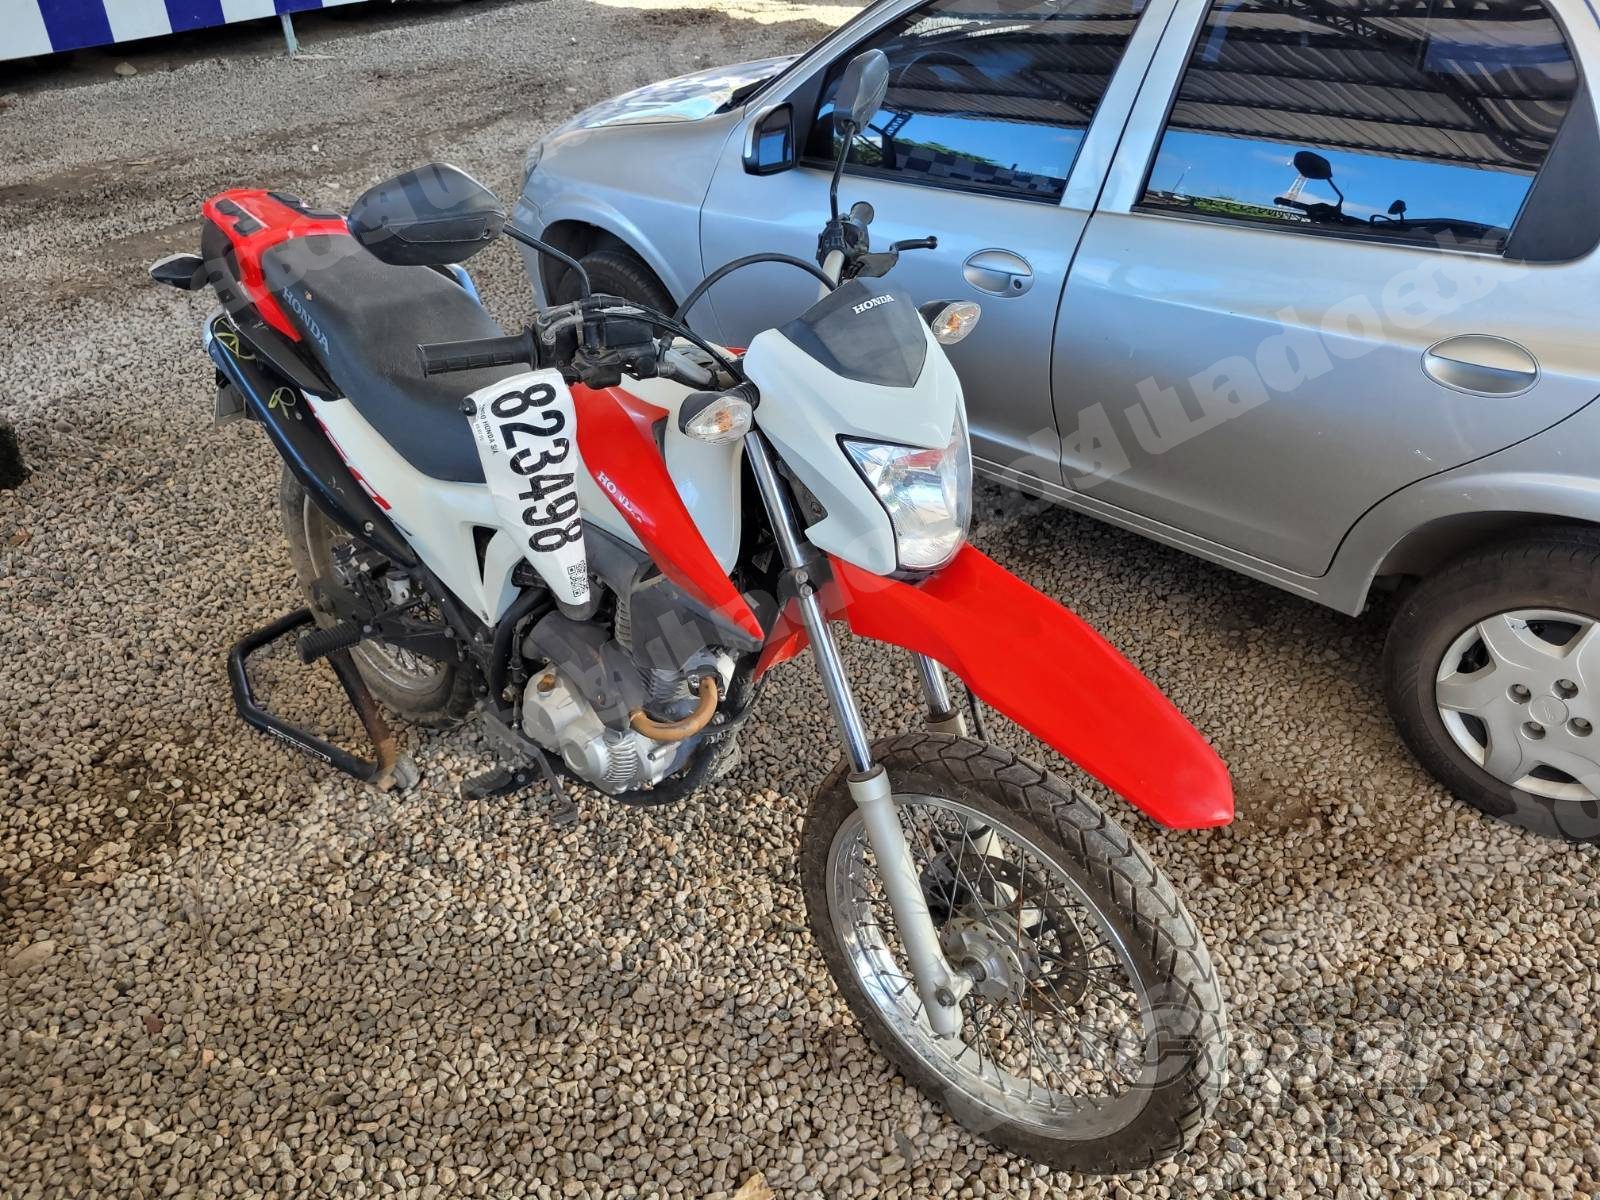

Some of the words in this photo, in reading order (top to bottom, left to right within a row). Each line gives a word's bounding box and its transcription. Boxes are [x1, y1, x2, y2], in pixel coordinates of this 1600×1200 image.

[283, 286, 330, 354] HONDA
[851, 294, 895, 315] HONDA
[482, 420, 496, 443] HONDA
[490, 382, 583, 553] 823498
